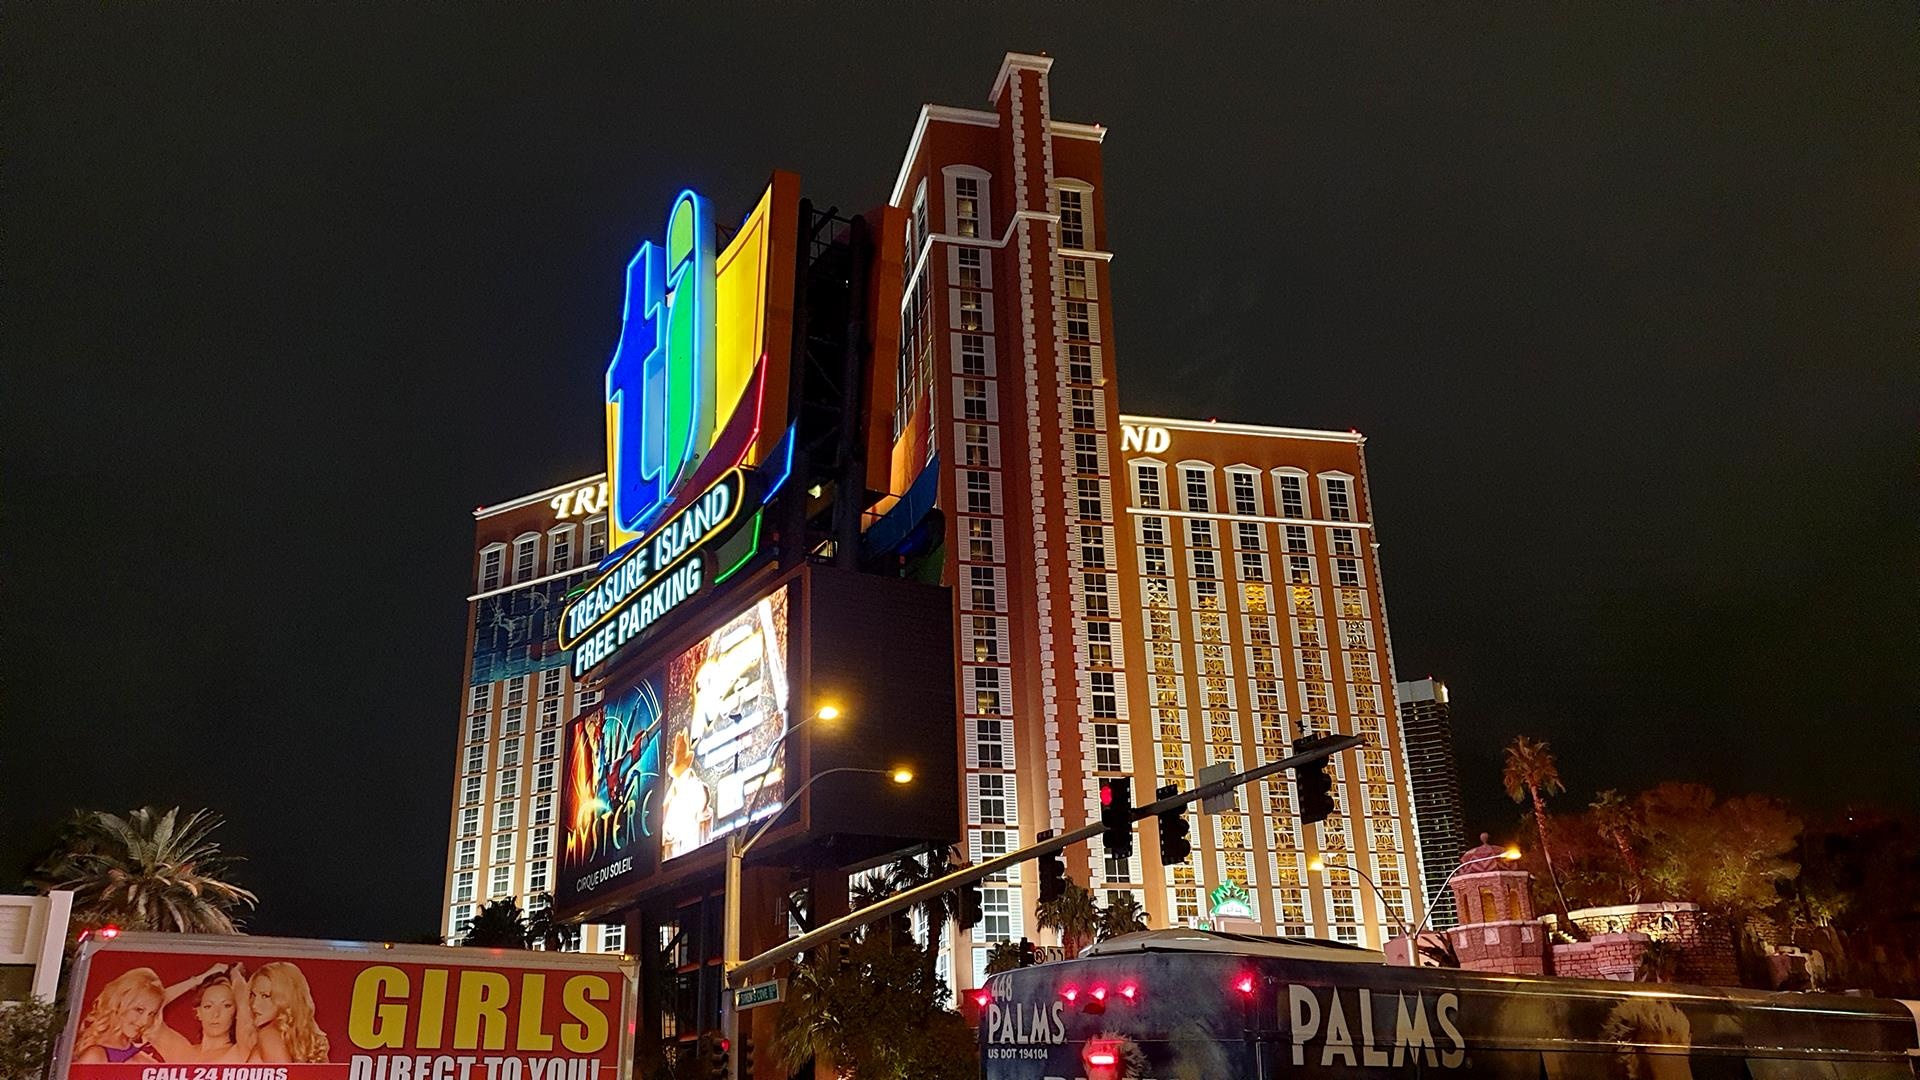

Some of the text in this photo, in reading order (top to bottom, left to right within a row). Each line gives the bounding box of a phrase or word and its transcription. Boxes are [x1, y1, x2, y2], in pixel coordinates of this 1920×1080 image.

[1120, 425, 1171, 454] ND
[568, 483, 730, 639] TREASURE ISLAND
[574, 557, 703, 677] FREE PARKING
[576, 857, 633, 892] CIRQUE DU SOLEIL
[991, 974, 1013, 1002] 448
[348, 965, 610, 1054] GIRLS
[988, 1001, 1066, 1045] PALMS
[1288, 983, 1466, 1069] PALMS
[349, 1054, 601, 1080] DIRECT TO YOU!
[988, 1048, 1048, 1060] US DOT 194104
[142, 1067, 288, 1080] CALL 24 HOURS
